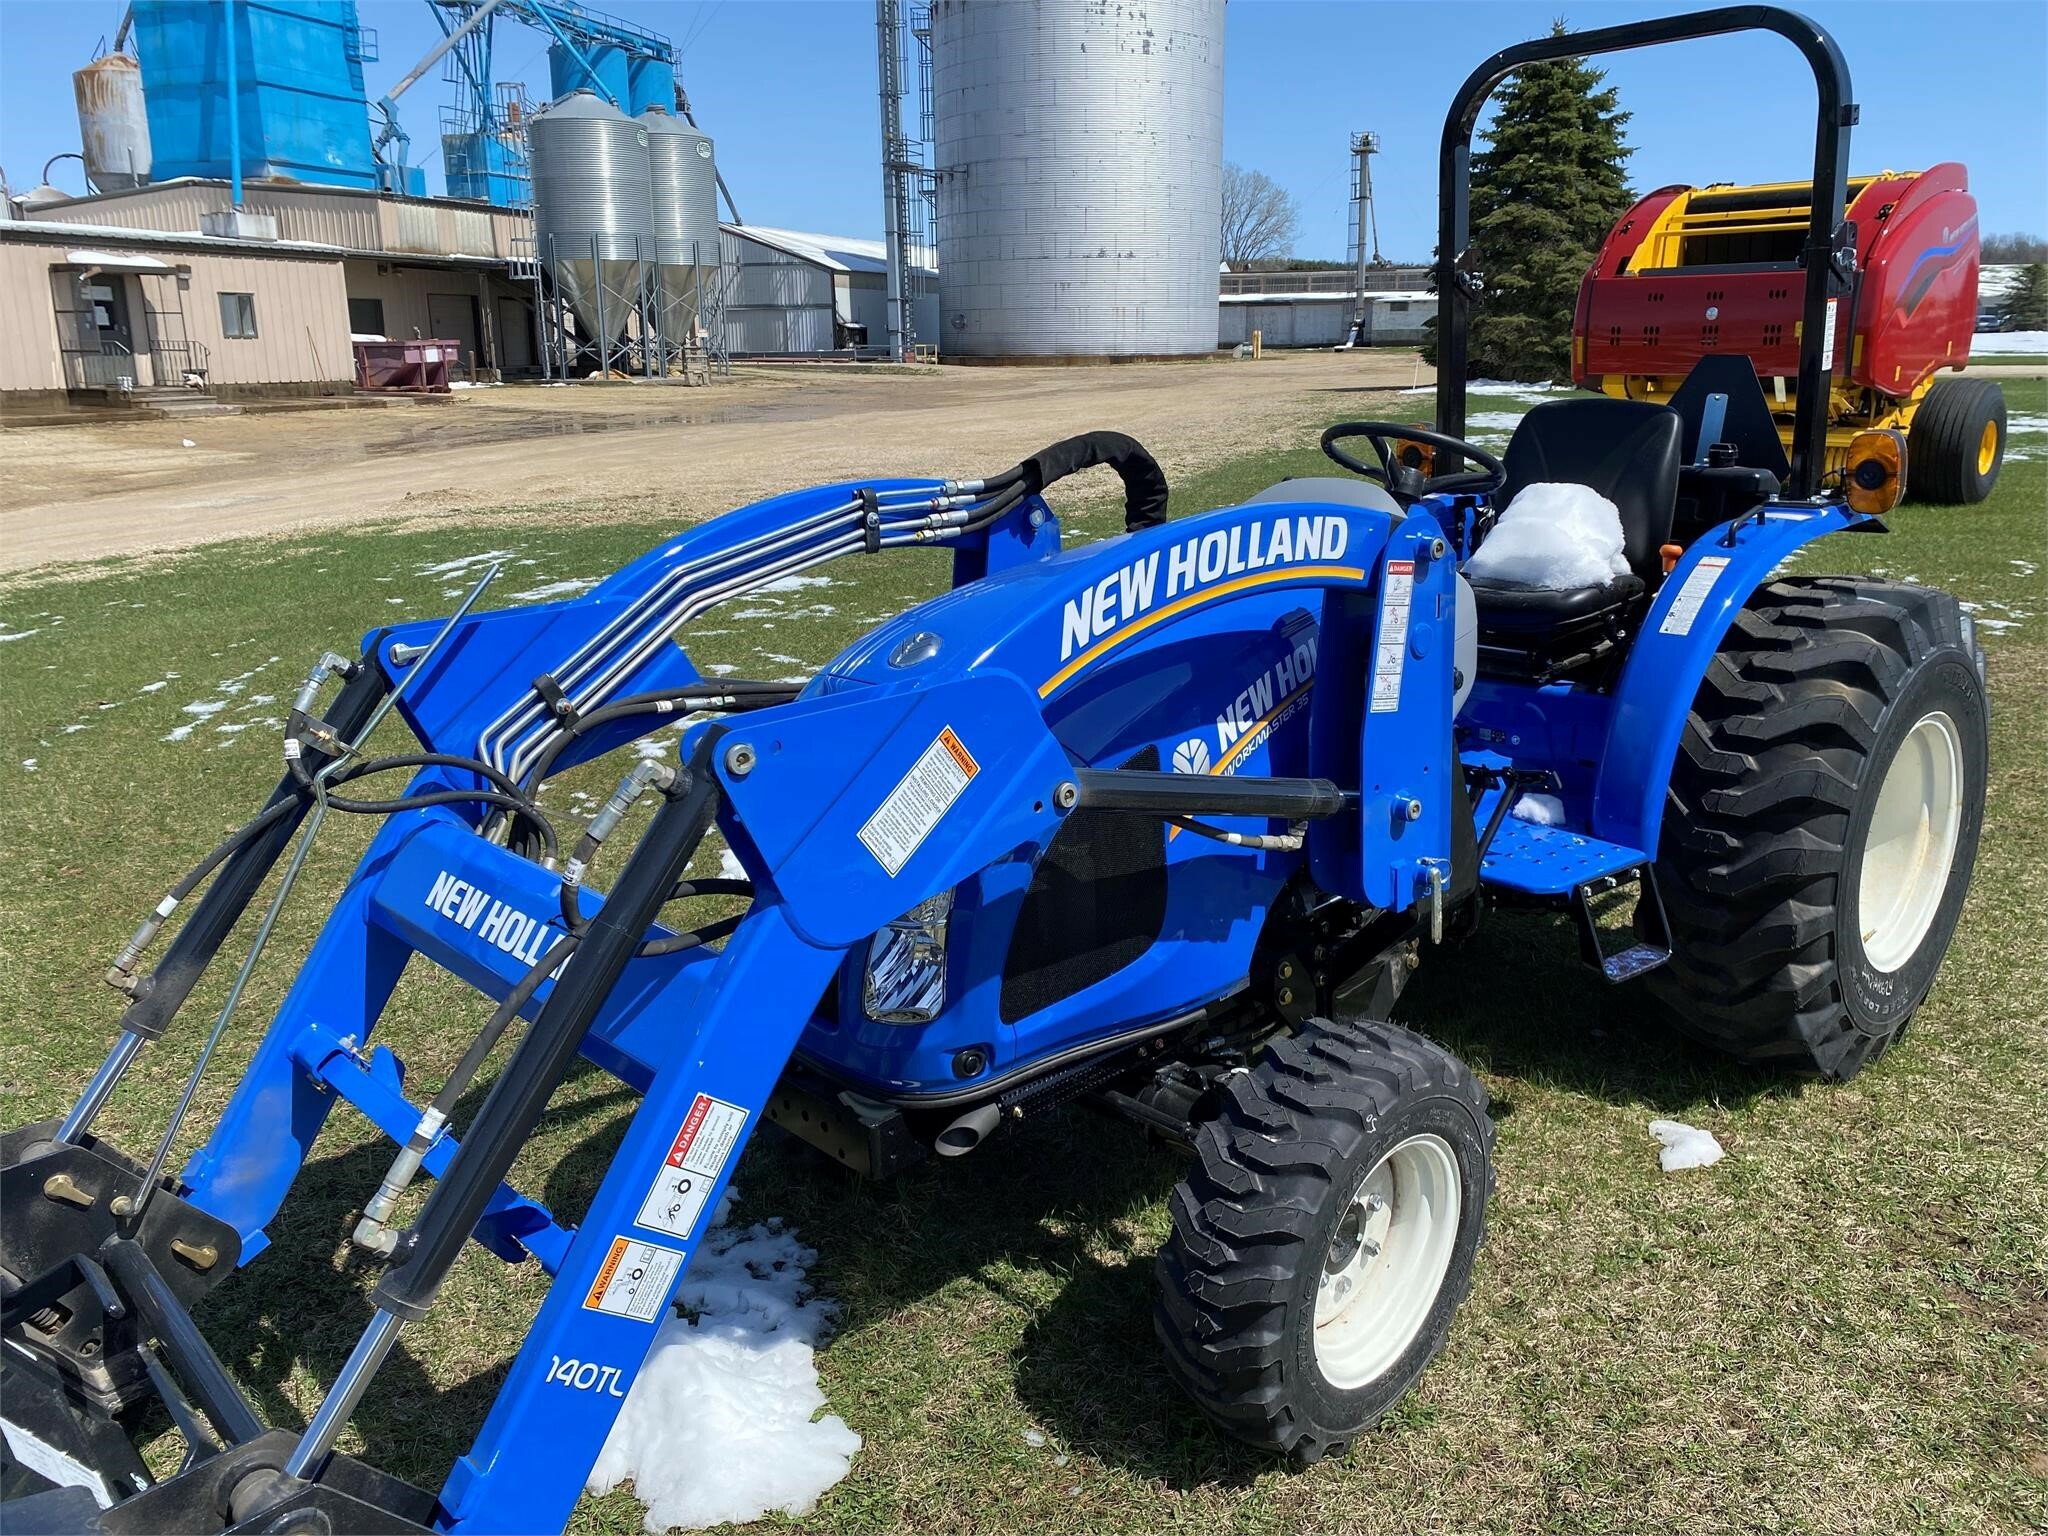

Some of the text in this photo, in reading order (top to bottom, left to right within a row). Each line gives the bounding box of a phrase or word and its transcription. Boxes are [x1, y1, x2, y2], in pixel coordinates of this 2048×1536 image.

[1060, 515, 1349, 662] NEW HOLLAND
[1216, 677, 1274, 754] NEW
[1224, 692, 1310, 777] WORKMASTER 35
[950, 742, 973, 773] WARNING
[424, 870, 575, 982] NEW HOLL
[678, 1101, 706, 1148] DANGER
[597, 1246, 623, 1289] WARNING
[545, 1354, 624, 1397] 140TL
